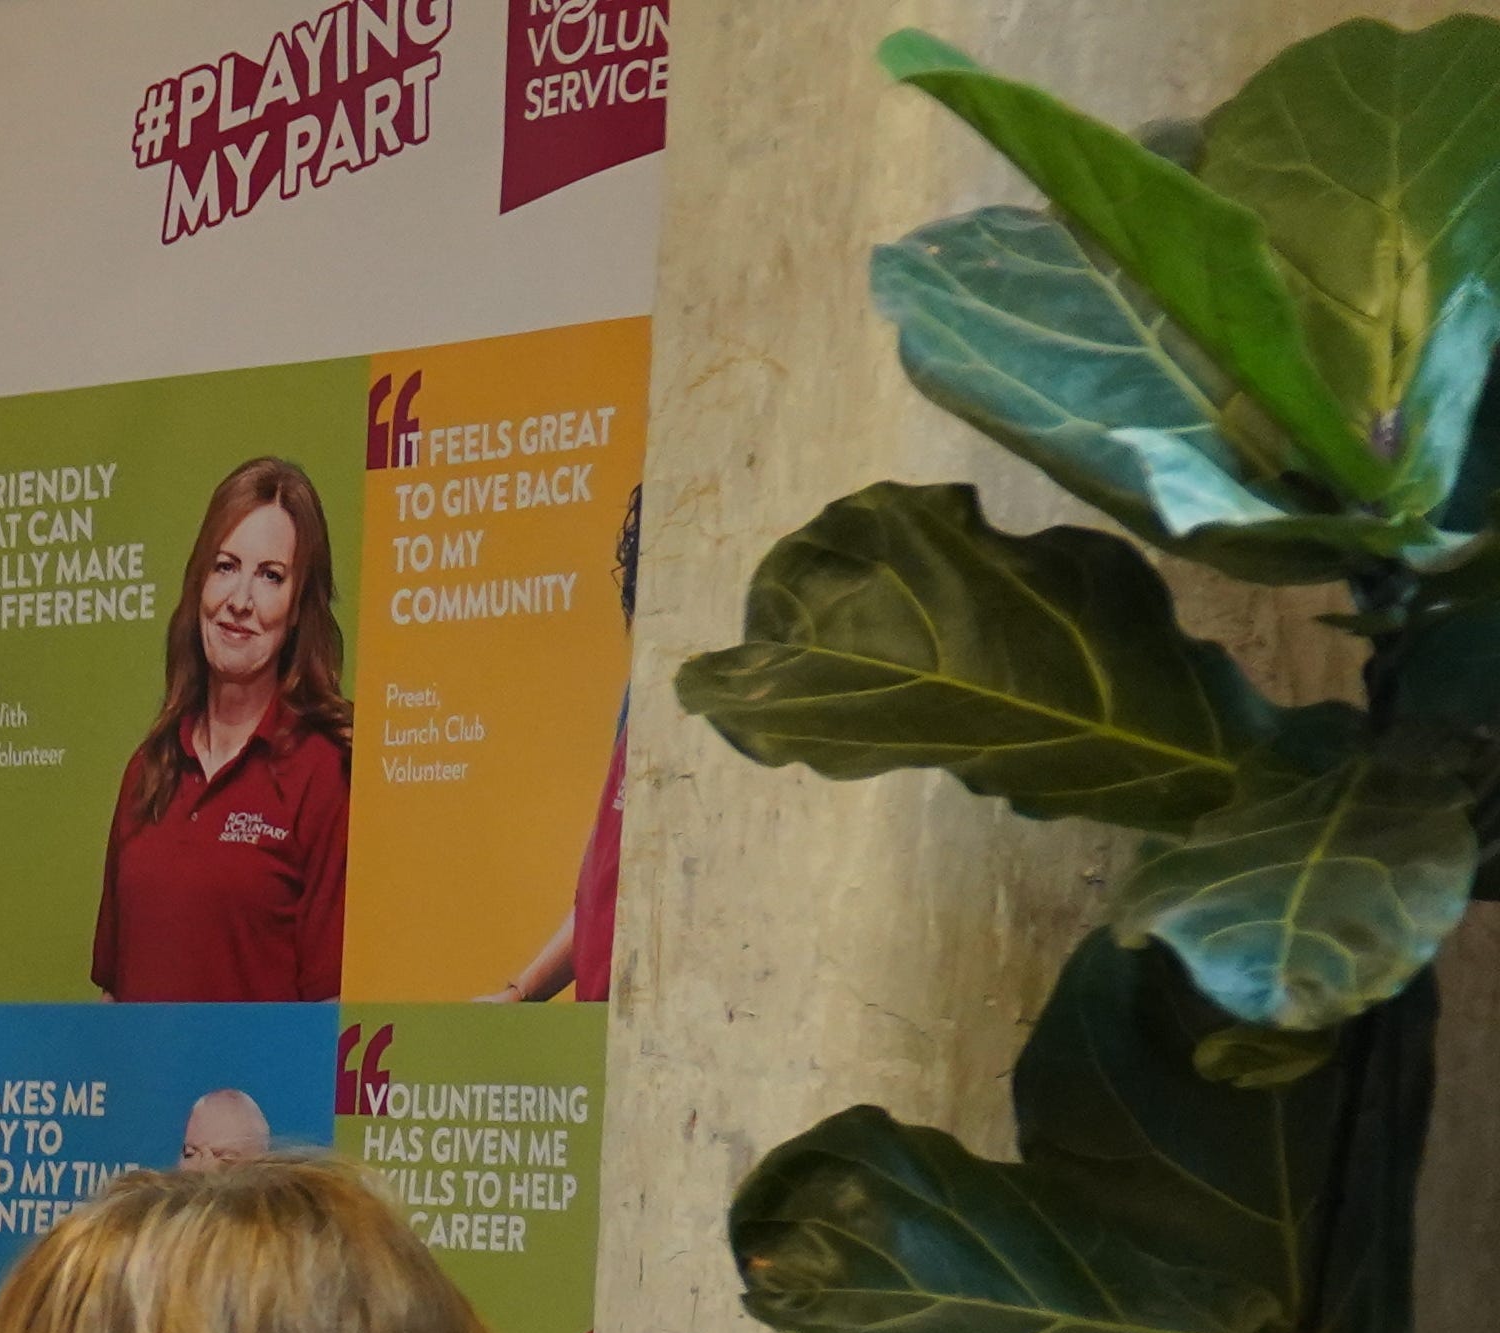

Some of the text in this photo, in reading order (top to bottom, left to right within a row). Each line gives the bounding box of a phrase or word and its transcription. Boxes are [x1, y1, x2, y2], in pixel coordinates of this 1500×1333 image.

[136, 0, 449, 164] #PLAYING
[524, 56, 669, 121] SERVICE
[164, 56, 439, 241] MY PART
[398, 406, 617, 469] IT FEELS GREAT
[395, 463, 594, 523] TO GIVE BACK
[27, 506, 94, 547] CAN
[55, 543, 146, 585] MAKE
[392, 529, 485, 574] TO MY
[390, 571, 578, 626] COMMUNITY
[385, 682, 441, 711] Preeti,
[383, 714, 486, 747] Lunch Club
[382, 755, 469, 784] Volunteer
[62, 1081, 107, 1117] ME
[364, 1082, 589, 1124] VOLUNTEERING
[23, 1119, 64, 1156] TO
[363, 1125, 569, 1168] HAS GIVEN ME
[19, 1159, 67, 1196] MY
[463, 1170, 501, 1208] TO
[508, 1172, 578, 1212] HELP
